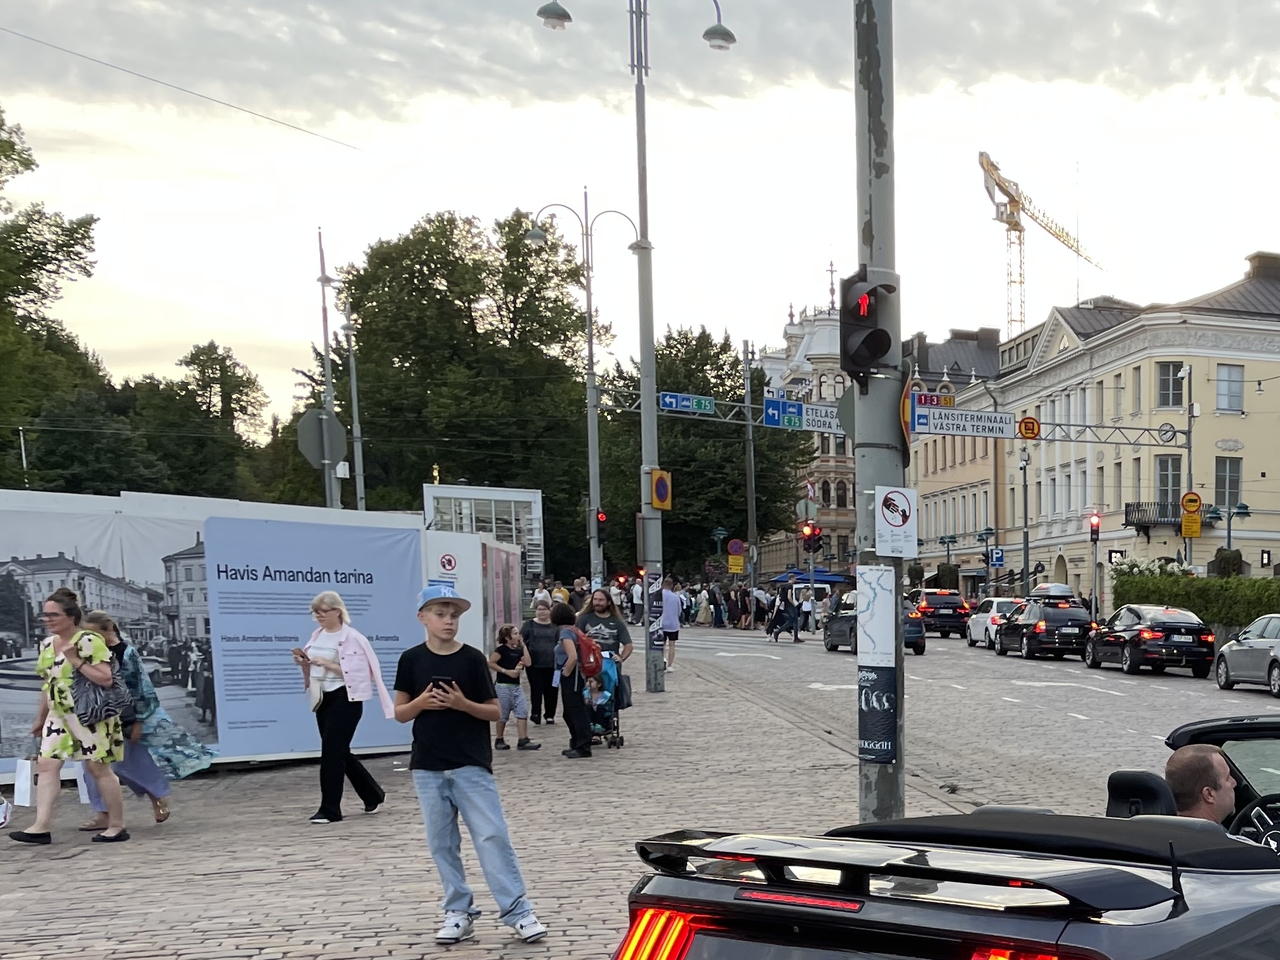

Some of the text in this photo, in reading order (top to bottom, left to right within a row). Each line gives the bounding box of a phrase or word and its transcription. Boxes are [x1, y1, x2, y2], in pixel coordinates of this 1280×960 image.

[692, 398, 711, 410] E 75
[931, 396, 937, 405] 3
[784, 416, 800, 426] E 75
[932, 411, 1012, 425] LÄNSITERMINAALI
[932, 421, 968, 432] VÄSTRA
[992, 549, 1002, 562] P
[217, 564, 374, 584] Havis Amandan tarina
